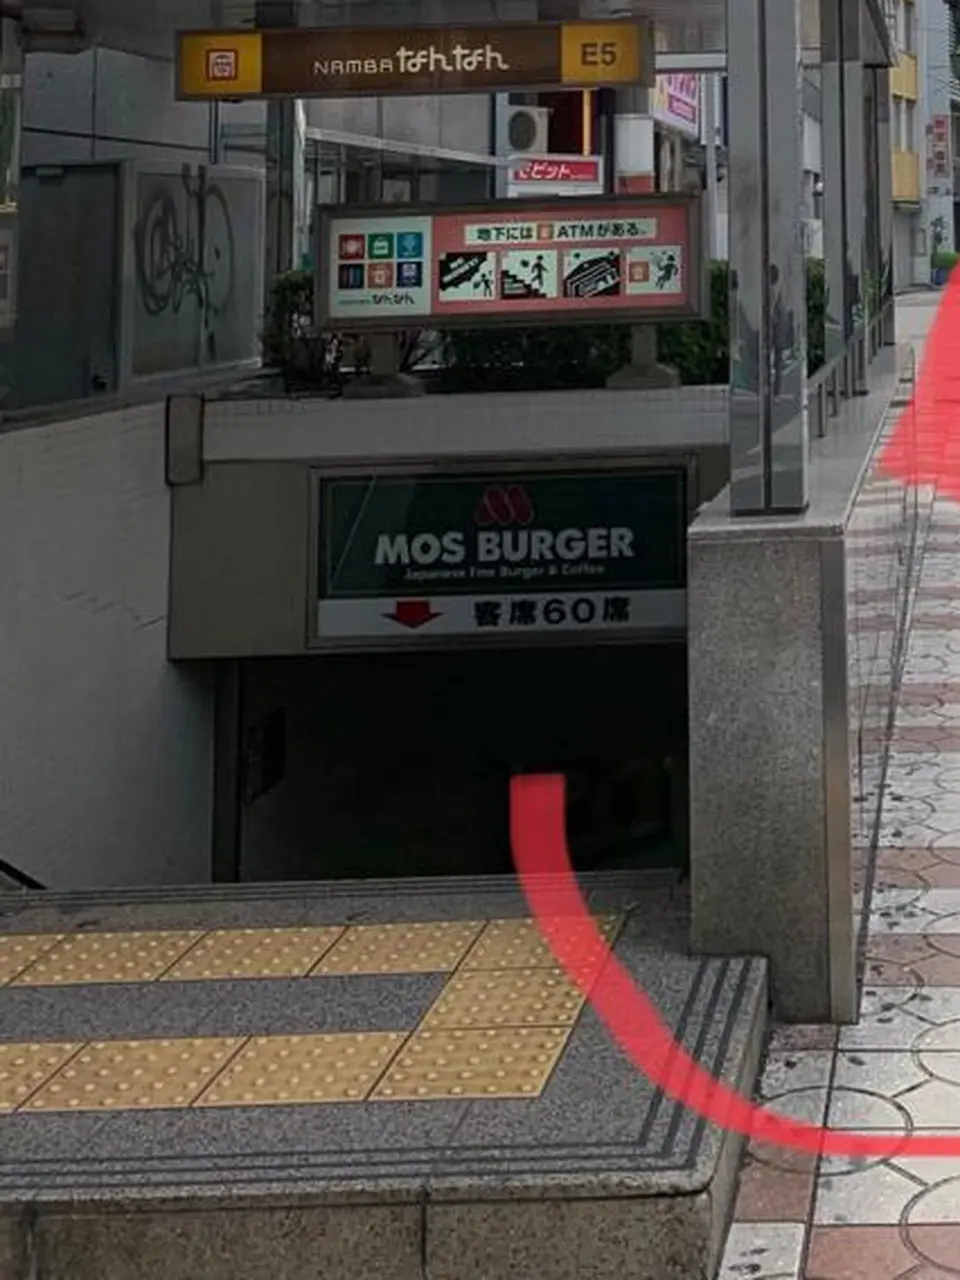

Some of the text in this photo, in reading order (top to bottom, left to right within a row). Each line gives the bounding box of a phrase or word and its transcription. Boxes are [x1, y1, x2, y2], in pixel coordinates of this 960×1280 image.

[314, 58, 394, 75] NAMBA
[580, 41, 617, 66] E5
[374, 527, 636, 565] MOS BURGER
[474, 596, 631, 626] 客席60席
